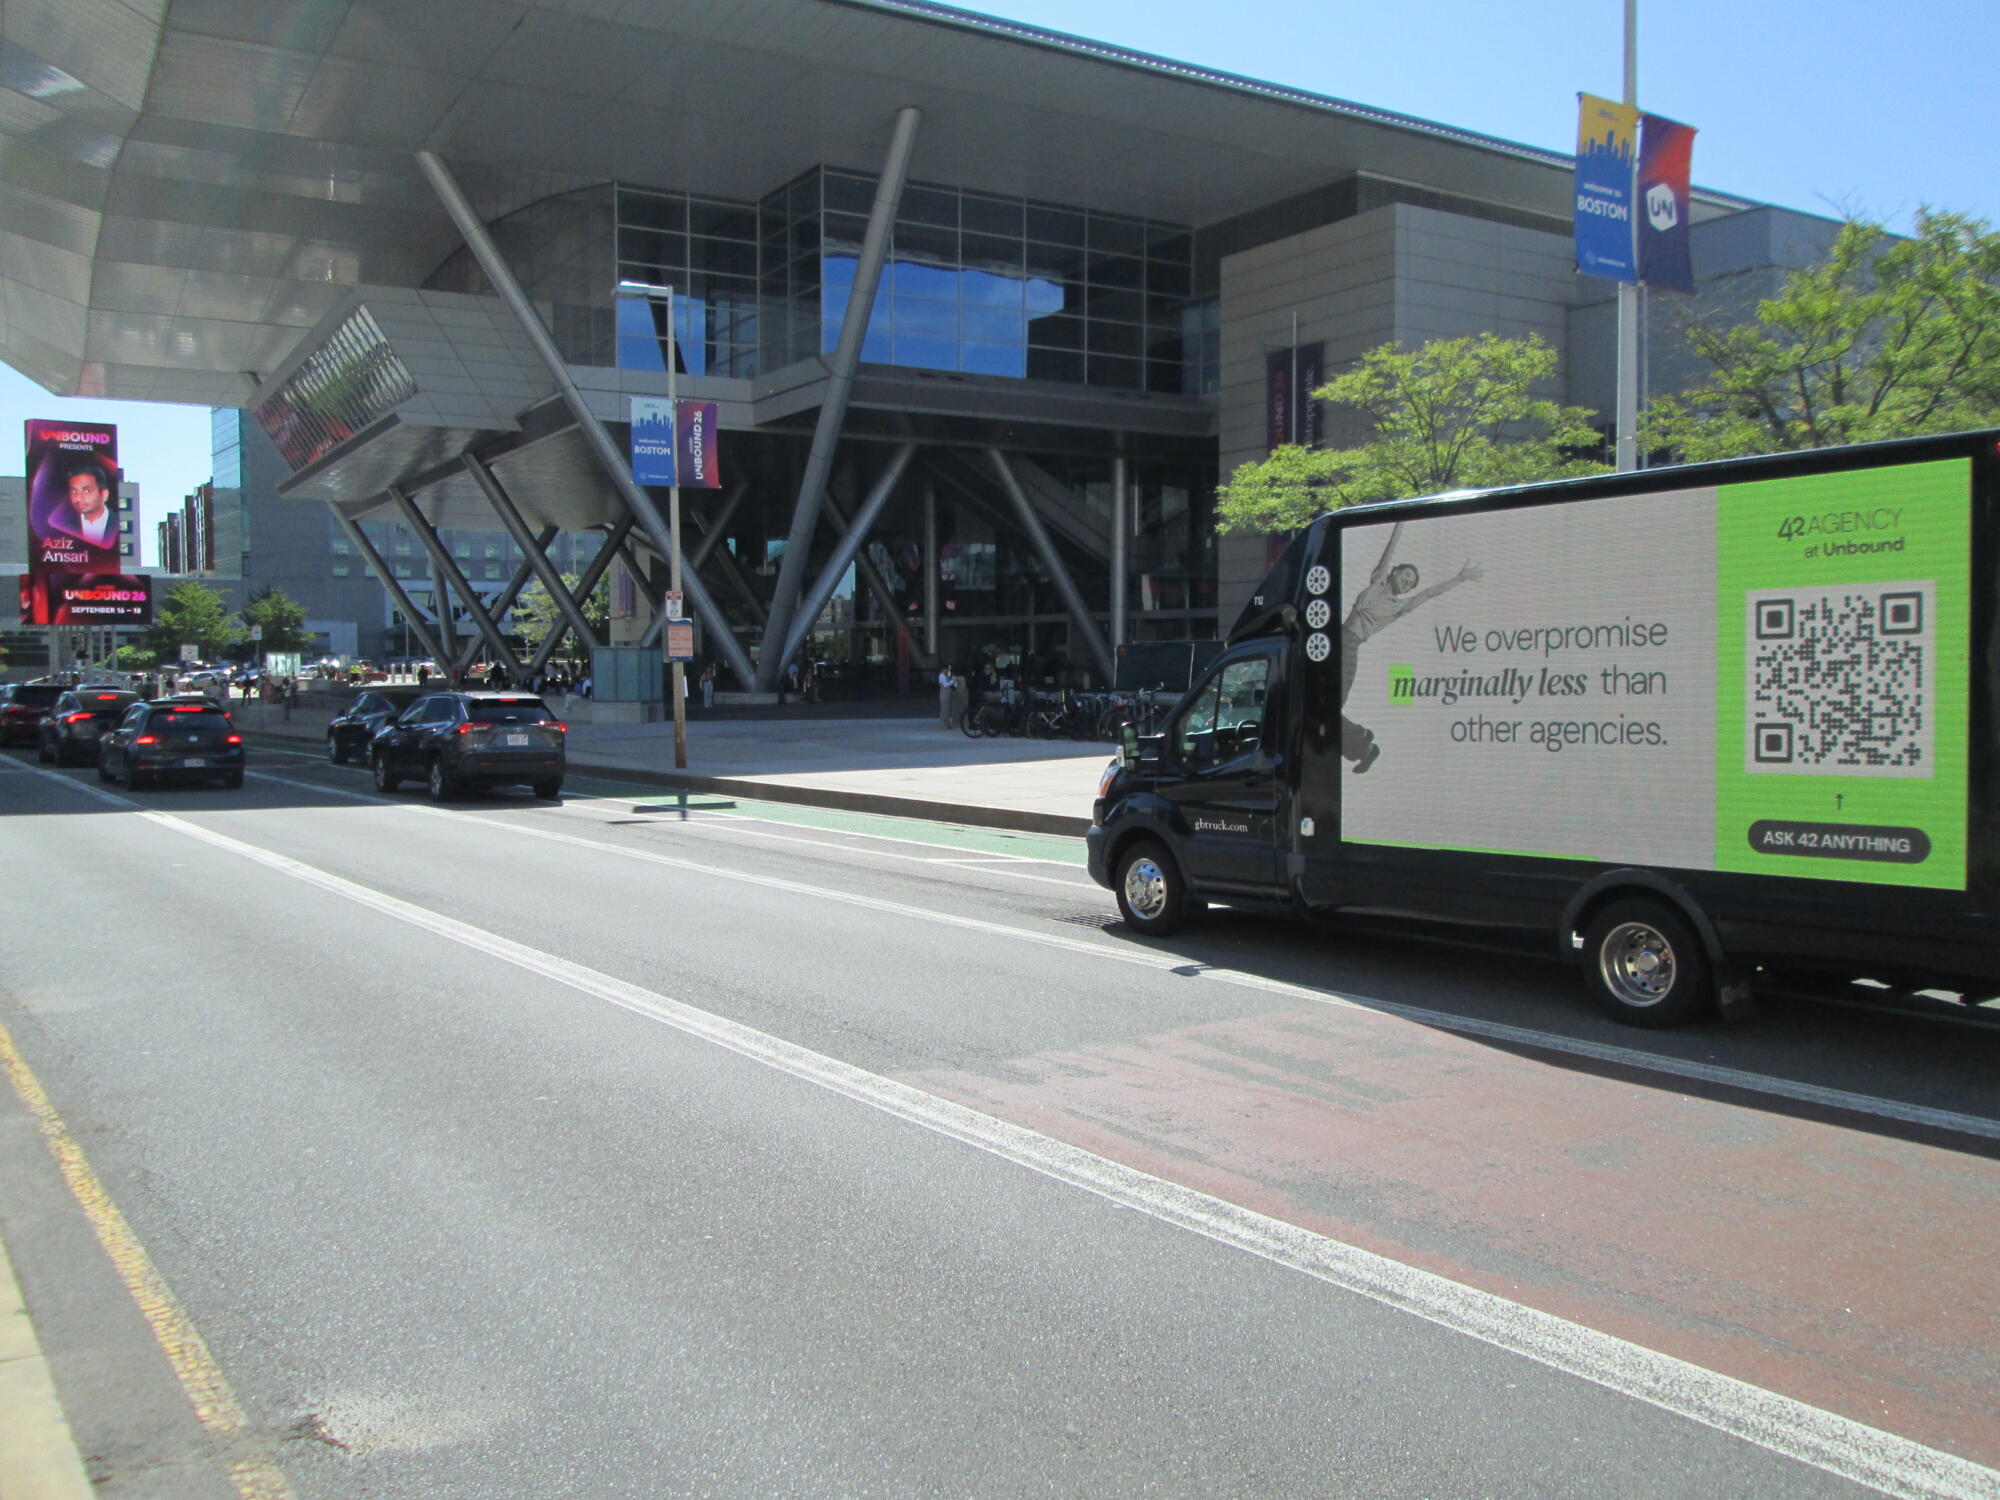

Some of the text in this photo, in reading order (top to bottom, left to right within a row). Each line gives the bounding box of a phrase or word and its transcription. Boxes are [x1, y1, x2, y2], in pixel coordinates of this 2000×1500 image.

[1577, 194, 1627, 222] BOSTON
[39, 430, 110, 444] UNBOUND
[59, 443, 94, 451] PRESENTS
[694, 410, 704, 480] UNBOUND 26
[634, 445, 671, 456] BOSTON
[1777, 507, 1904, 541] 42 AGENCY
[42, 538, 74, 549] Aziz
[1804, 536, 1904, 558] at Unbound
[43, 550, 88, 562] Ansari
[64, 590, 146, 601] UNBOUND 26
[1435, 616, 1668, 658] We overpromise
[1393, 664, 1667, 705] marginally less than
[1451, 714, 1668, 752] other agencies.
[1194, 818, 1248, 832] gbtruck.com
[1763, 831, 1911, 854] ASK 42 ANYTHING
